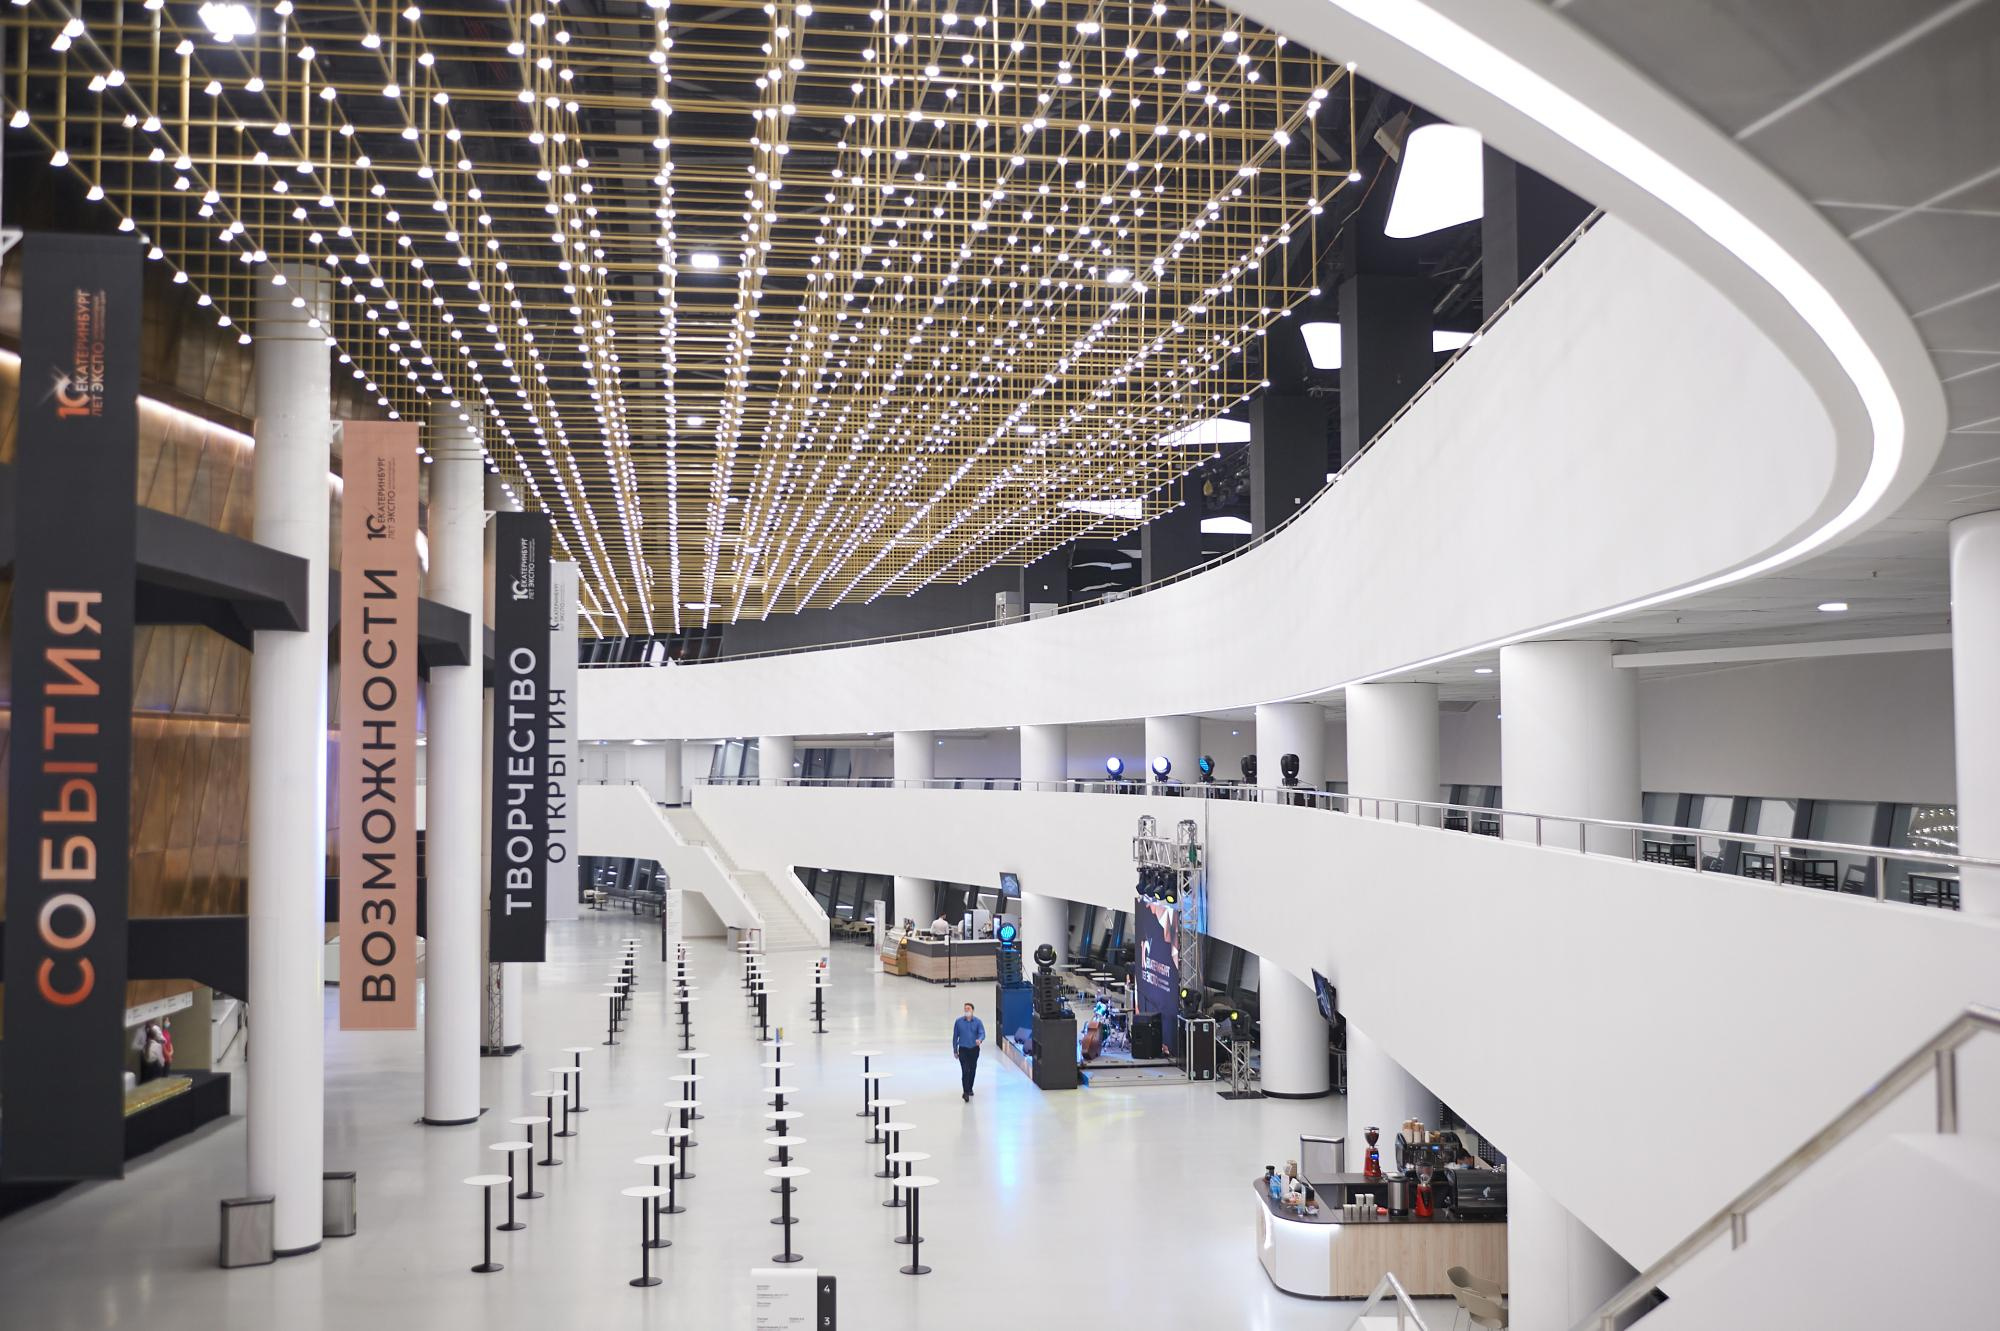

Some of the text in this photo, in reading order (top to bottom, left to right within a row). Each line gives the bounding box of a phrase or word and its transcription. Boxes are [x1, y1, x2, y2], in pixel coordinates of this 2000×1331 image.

[76, 289, 90, 392] ЕКАТЕРИНБУРГ
[91, 342, 104, 392] ЭКСПО
[91, 395, 104, 416] ЛЕТ
[377, 457, 386, 523] ЕКАТЕРИНБУРГ
[387, 490, 396, 523] ЭКСПО
[520, 538, 528, 587] ЕКАТЕРИНБУРГ
[38, 591, 102, 1005] СОБЫТИЯ
[362, 570, 398, 1001] ВОЗМОЖНОСТИ
[506, 647, 536, 915] ТВОРЧЕСТВО
[548, 690, 566, 863] ОТКРЫТИЯ
[823, 1284, 831, 1293] 4
[823, 1316, 831, 1326] 3
